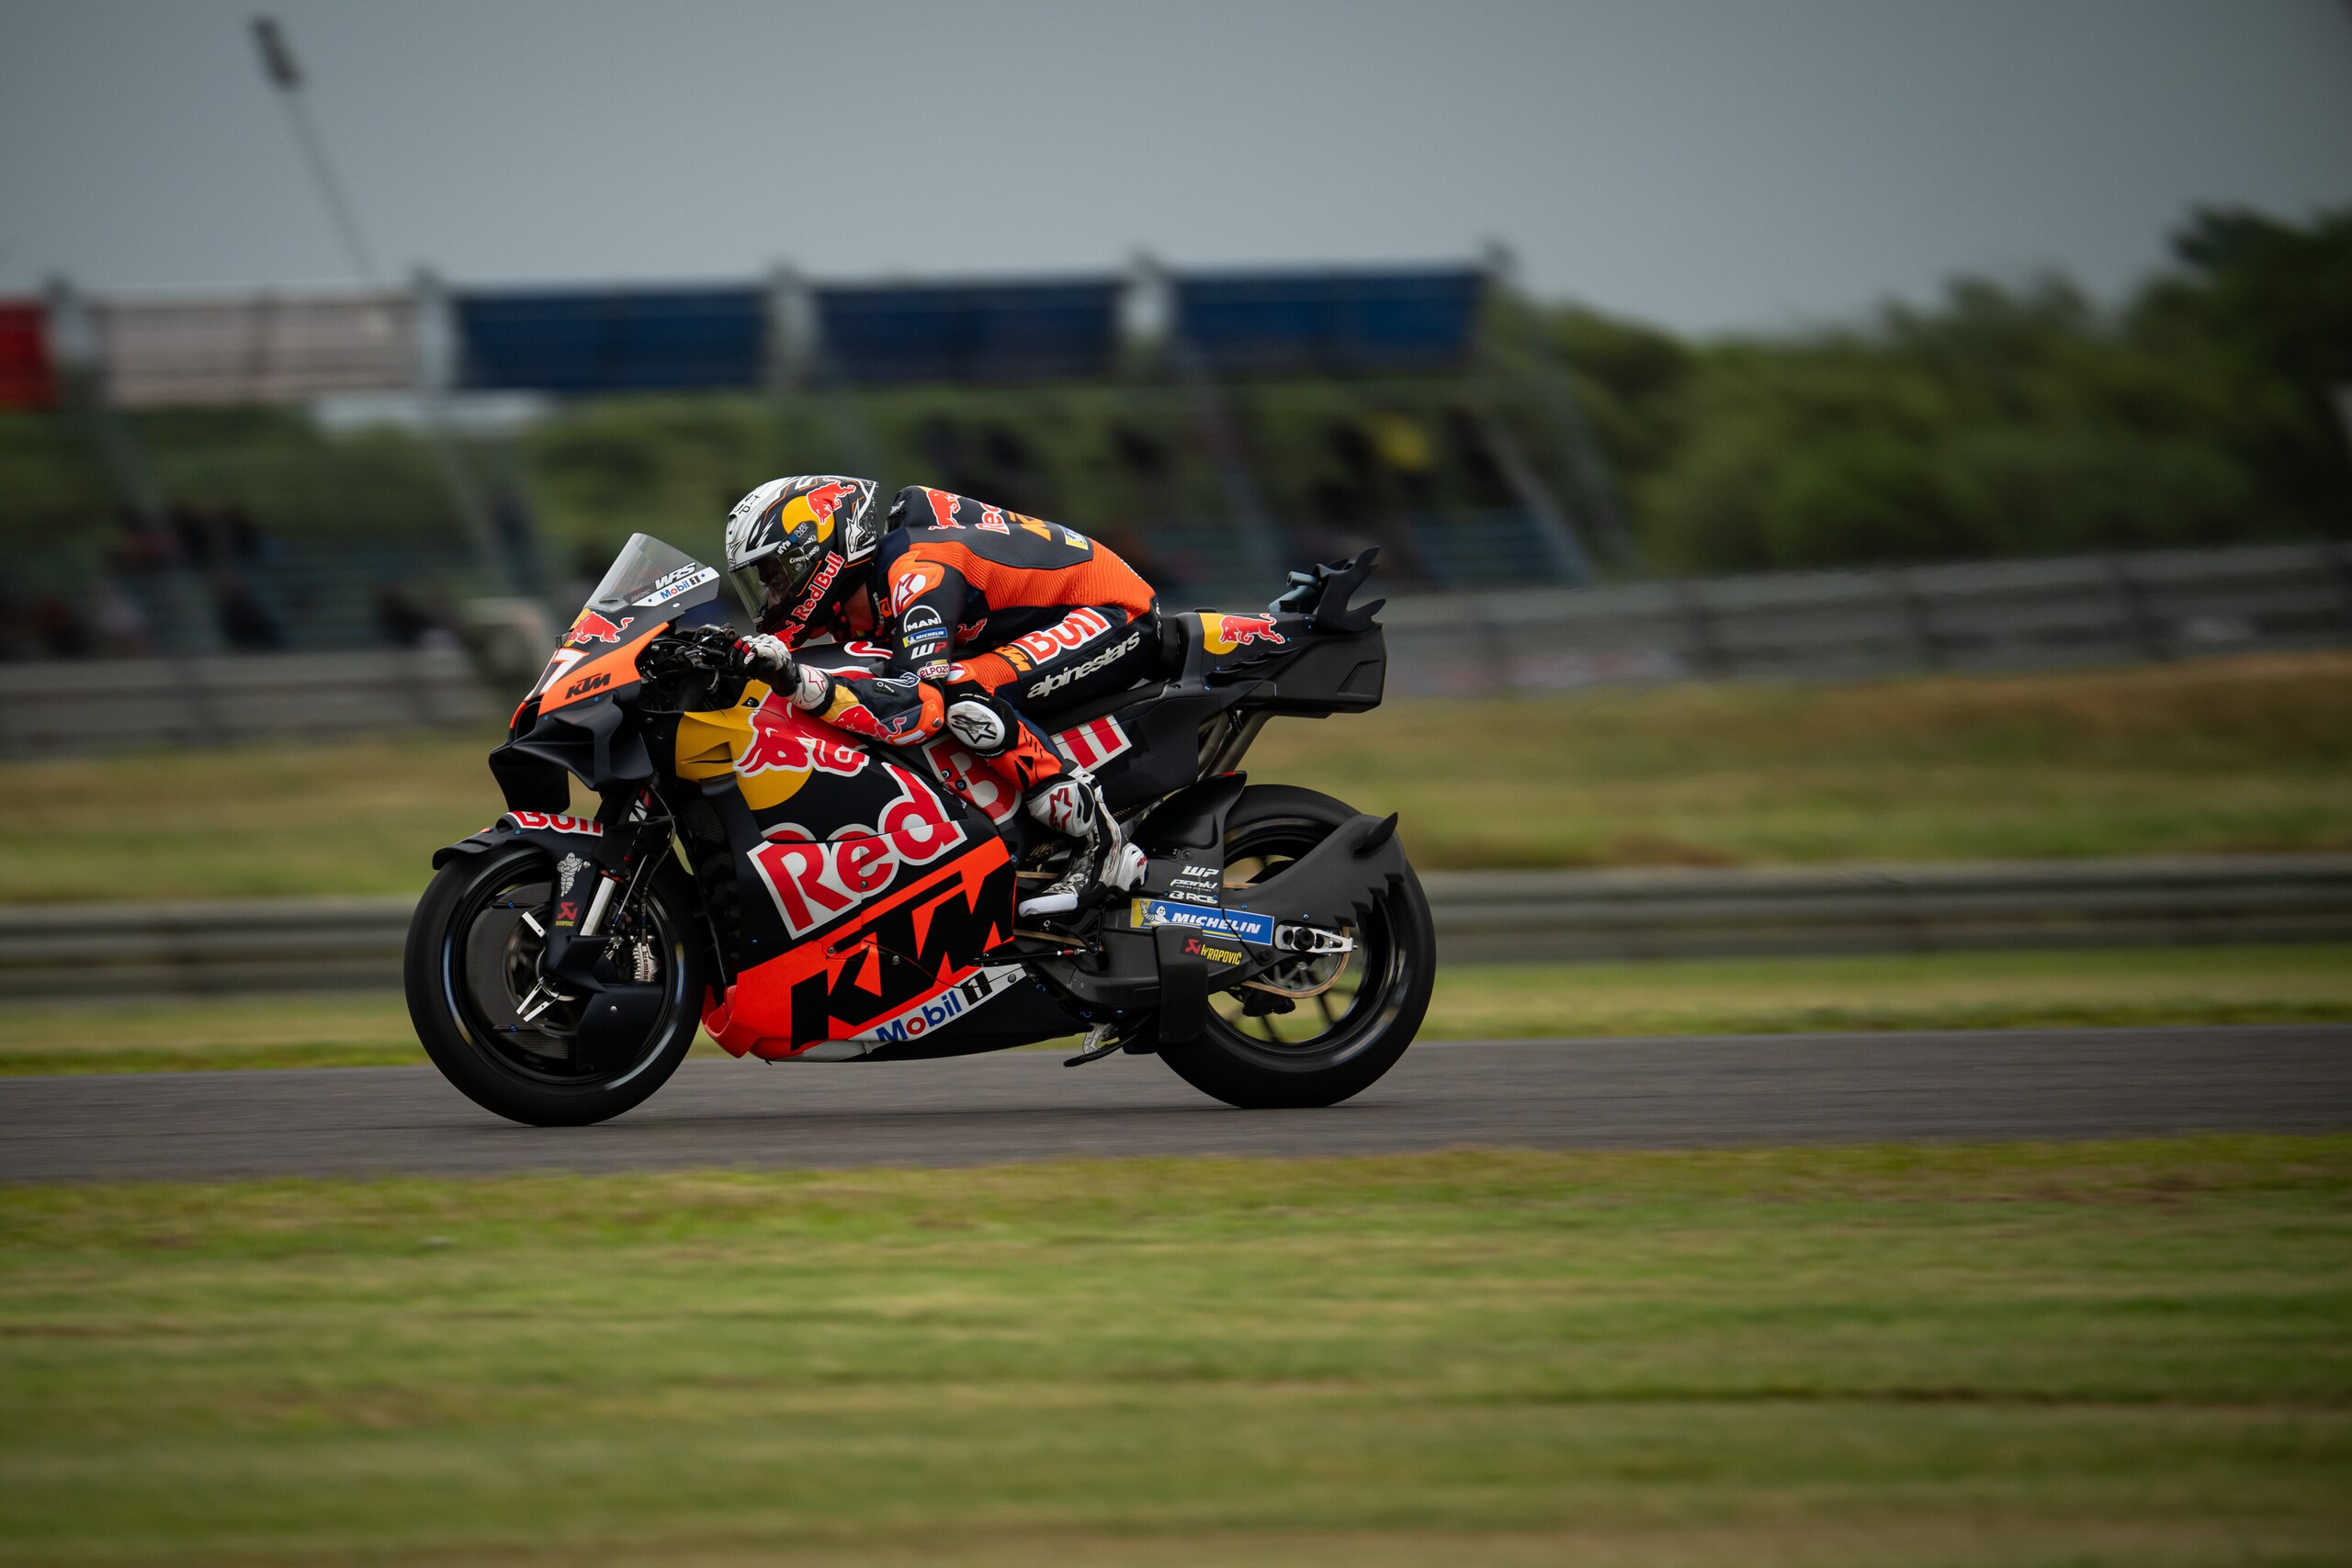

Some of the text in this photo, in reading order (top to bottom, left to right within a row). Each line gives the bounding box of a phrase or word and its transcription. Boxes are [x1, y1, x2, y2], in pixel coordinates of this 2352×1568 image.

[655, 561, 696, 590] WRS
[791, 583, 826, 621] Red
[812, 550, 845, 591] Bull
[660, 580, 691, 600] Mobil
[907, 617, 939, 632] MAN
[916, 630, 944, 640] MICHELIN
[1011, 607, 1113, 666] Bull
[910, 641, 947, 660] WP
[1027, 631, 1140, 699] alpinestars
[564, 672, 611, 700] KTM
[747, 762, 967, 940] Red
[1182, 865, 1219, 877] WP
[1171, 912, 1261, 934] MICHELIN
[791, 863, 1014, 1051] KTM
[876, 990, 962, 1042] Mobil
